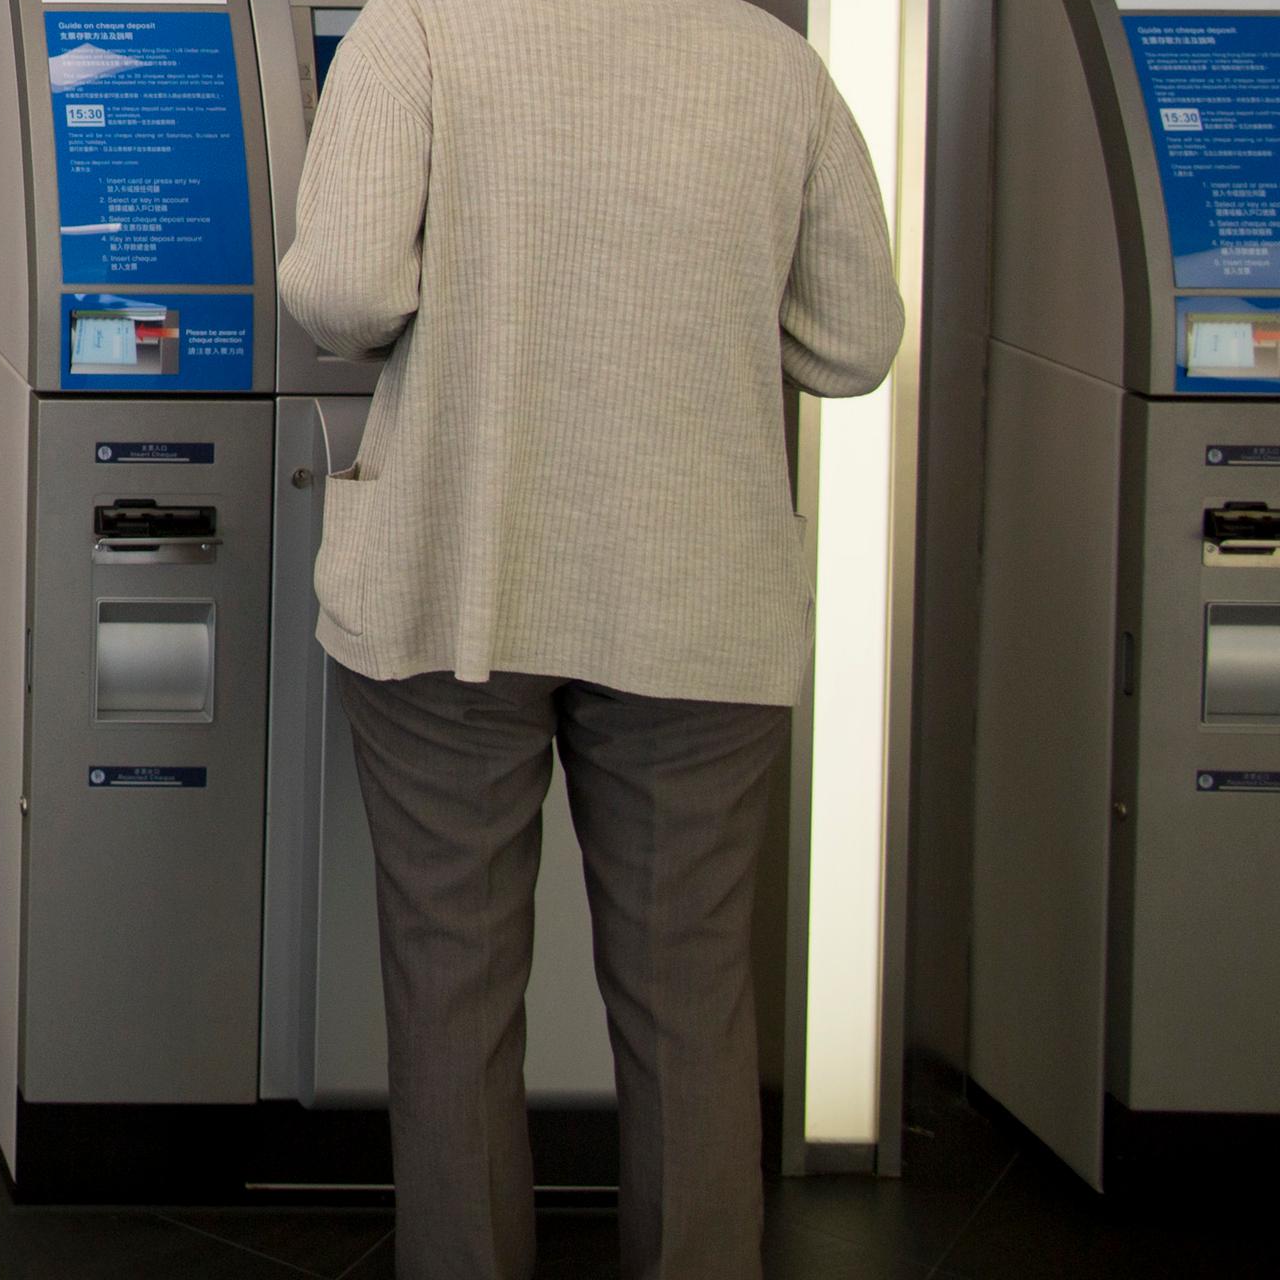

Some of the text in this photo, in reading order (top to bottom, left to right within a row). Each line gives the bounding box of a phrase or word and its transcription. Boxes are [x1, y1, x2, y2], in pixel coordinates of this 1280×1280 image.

[58, 22, 82, 30] Guide
[96, 22, 125, 31] cheque
[126, 22, 155, 31] deposit
[68, 109, 103, 119] 15:30
